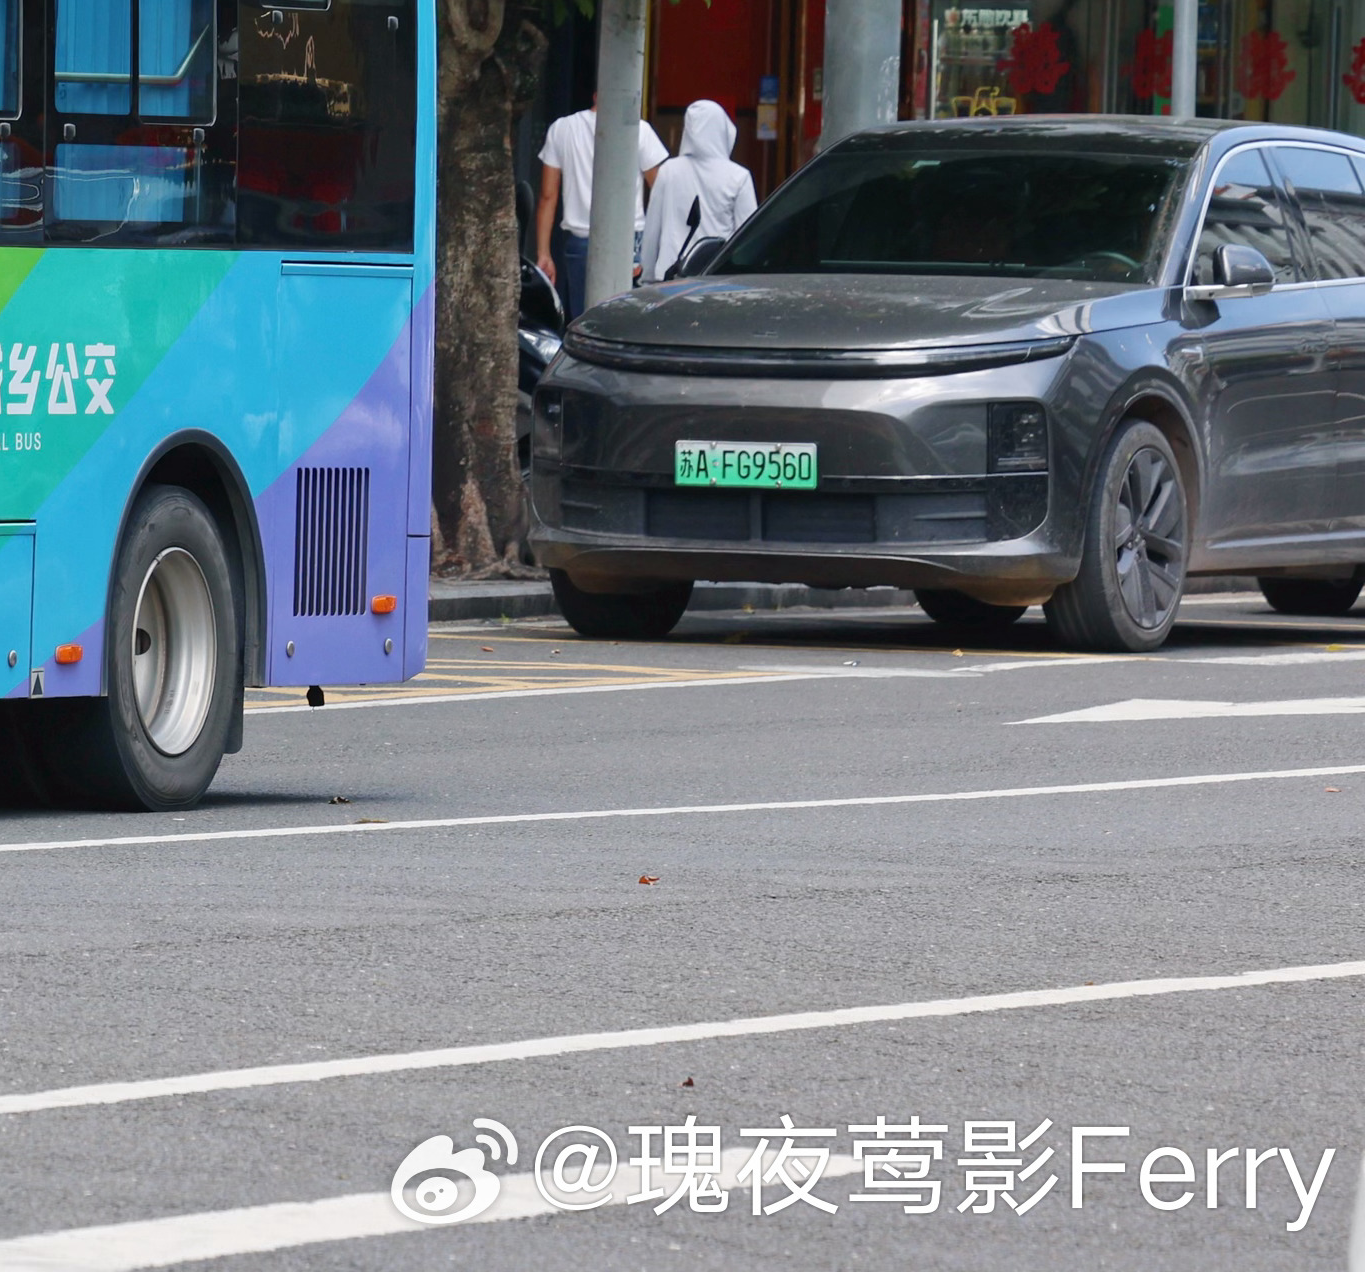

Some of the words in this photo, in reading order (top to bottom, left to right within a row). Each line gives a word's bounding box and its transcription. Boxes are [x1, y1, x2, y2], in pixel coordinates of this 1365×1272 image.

[15, 432, 42, 451] BUS
[680, 449, 709, 478] 苏A
[722, 450, 812, 481] FG9560
